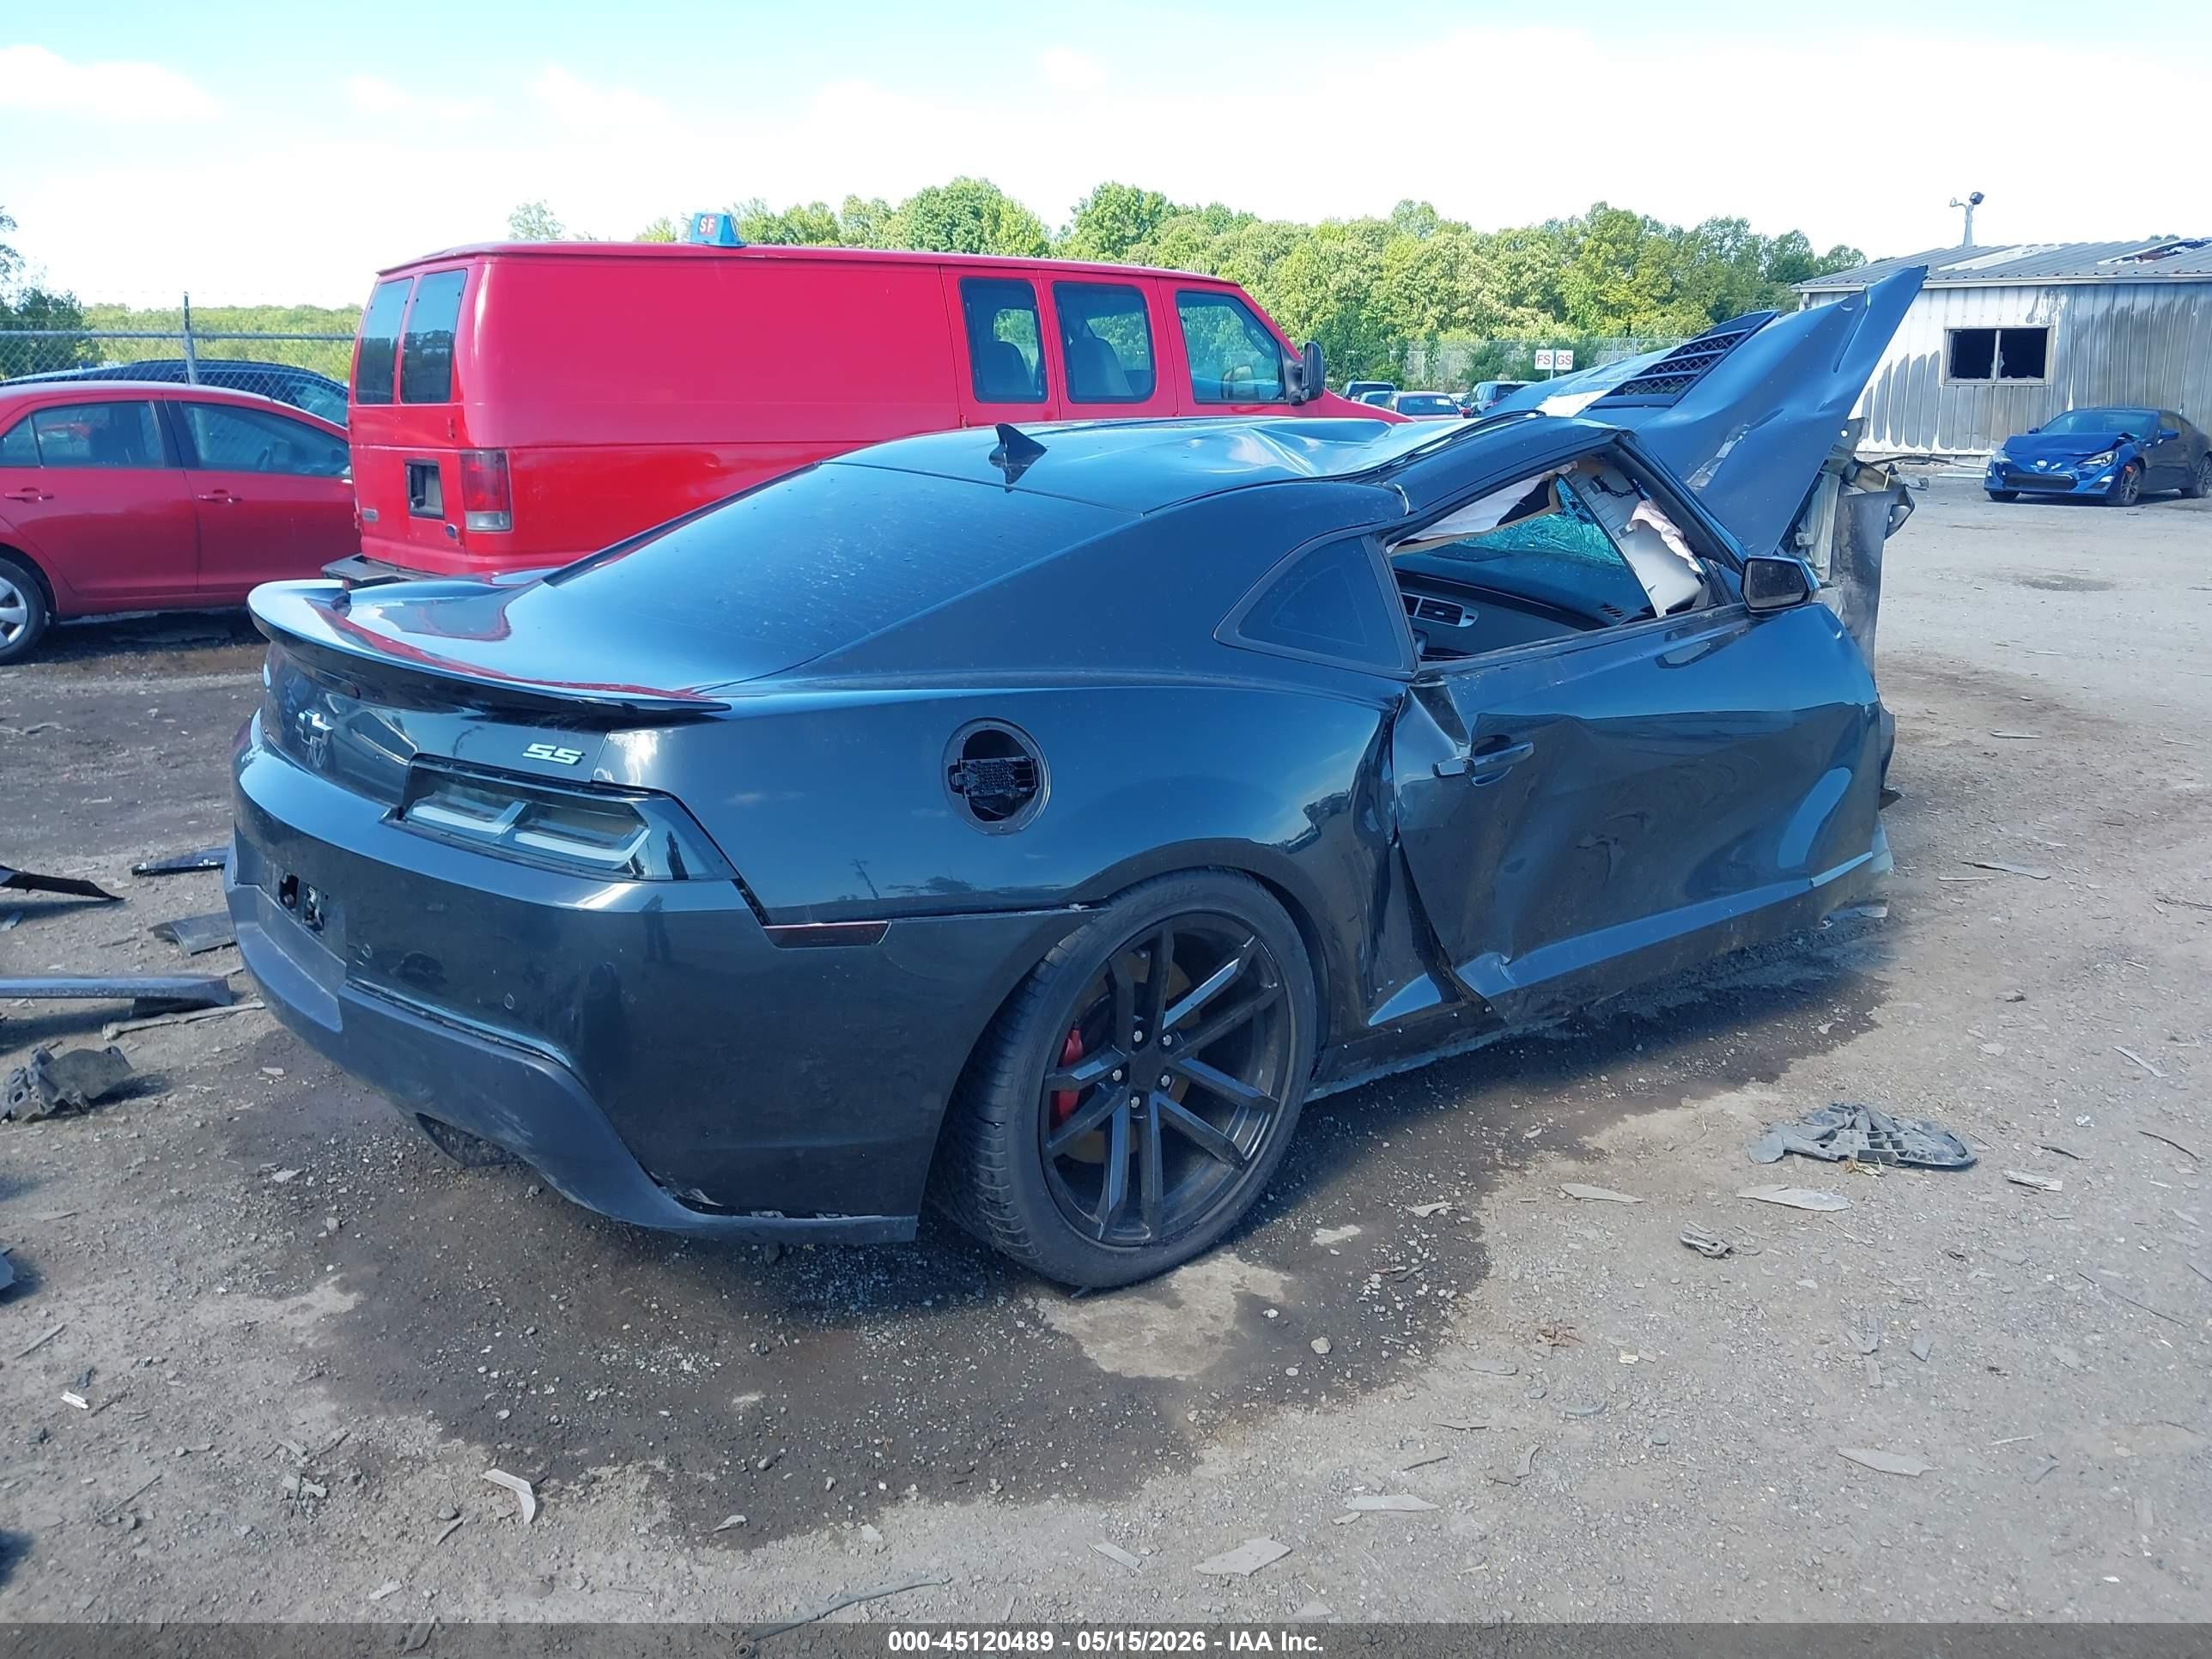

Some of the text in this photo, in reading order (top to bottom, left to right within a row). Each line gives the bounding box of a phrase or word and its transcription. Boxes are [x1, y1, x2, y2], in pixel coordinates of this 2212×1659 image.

[699, 216, 715, 234] SF
[1536, 354, 1551, 366] FS
[1556, 354, 1572, 366] GS
[521, 742, 585, 765] SS
